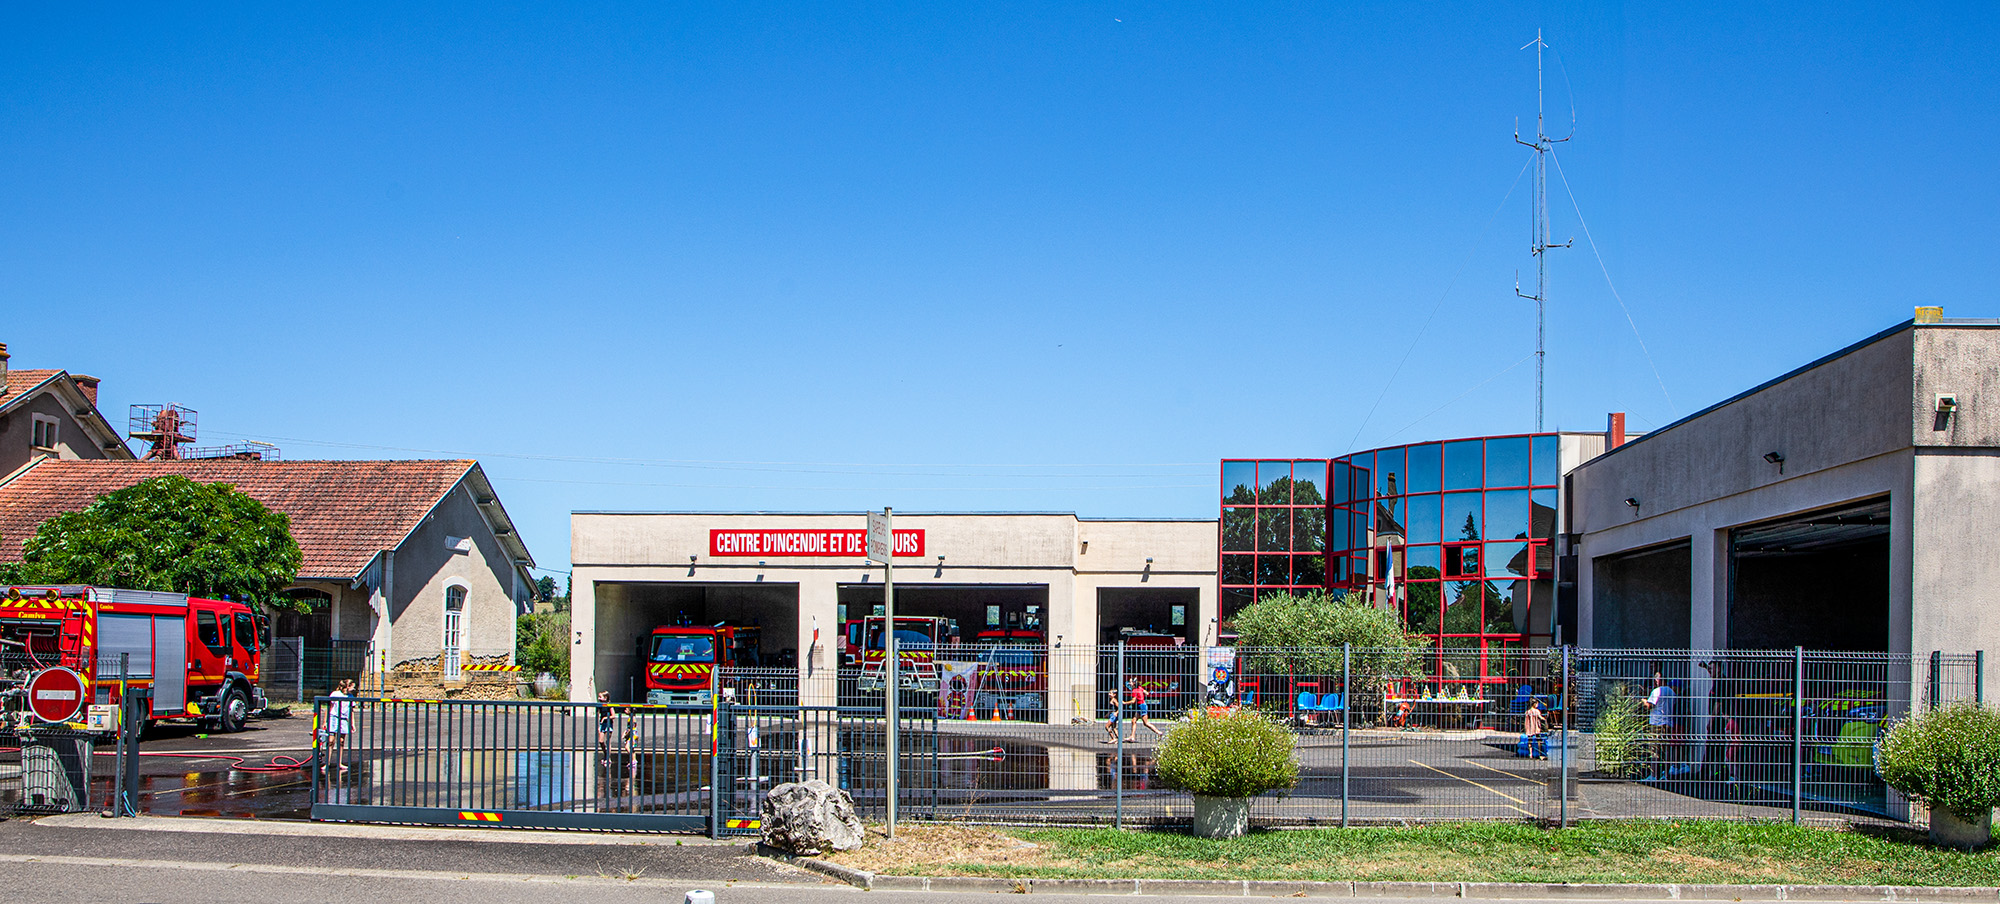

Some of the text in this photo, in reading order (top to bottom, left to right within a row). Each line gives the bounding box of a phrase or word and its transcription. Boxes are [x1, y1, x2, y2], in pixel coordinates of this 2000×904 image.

[716, 532, 918, 553] CENTRE D'INCENDIE ET DE OURS
[18, 611, 46, 619] Camiva
